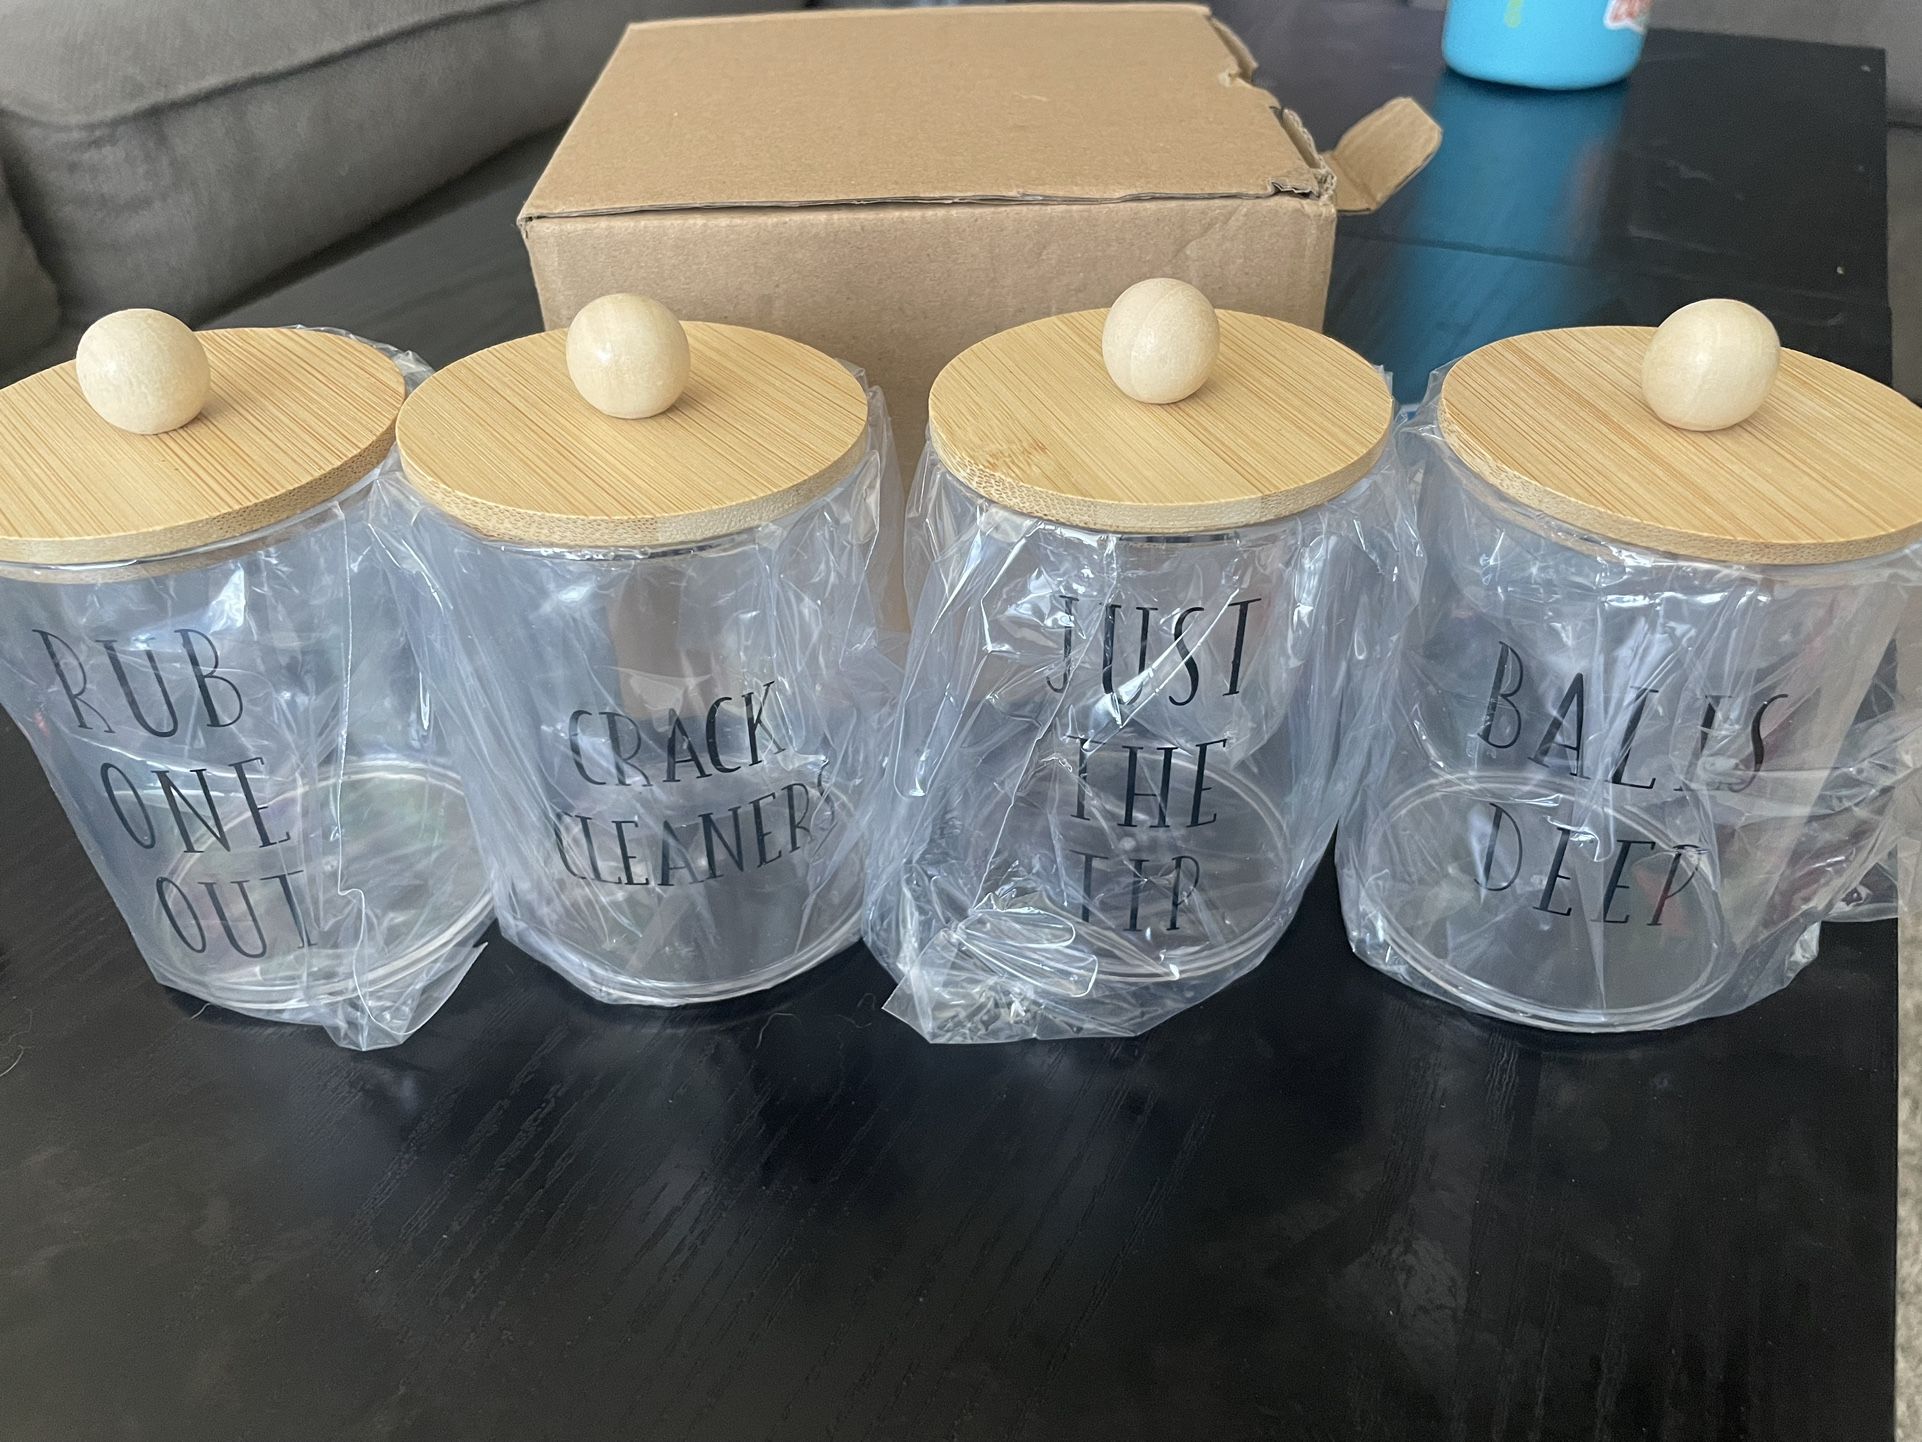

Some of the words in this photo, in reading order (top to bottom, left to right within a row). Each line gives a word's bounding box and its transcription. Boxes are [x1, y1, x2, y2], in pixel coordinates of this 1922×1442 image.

[32, 628, 244, 738] RUB
[1047, 594, 1262, 706] JUST
[568, 680, 786, 787] CRACK
[1478, 641, 1789, 793] BALLS
[100, 757, 291, 854] ONE
[551, 759, 838, 887] CLEANERS
[1066, 734, 1228, 828] THE
[156, 869, 318, 959] OUT
[1068, 850, 1201, 933] TIP
[1474, 802, 1702, 926] DEEP
